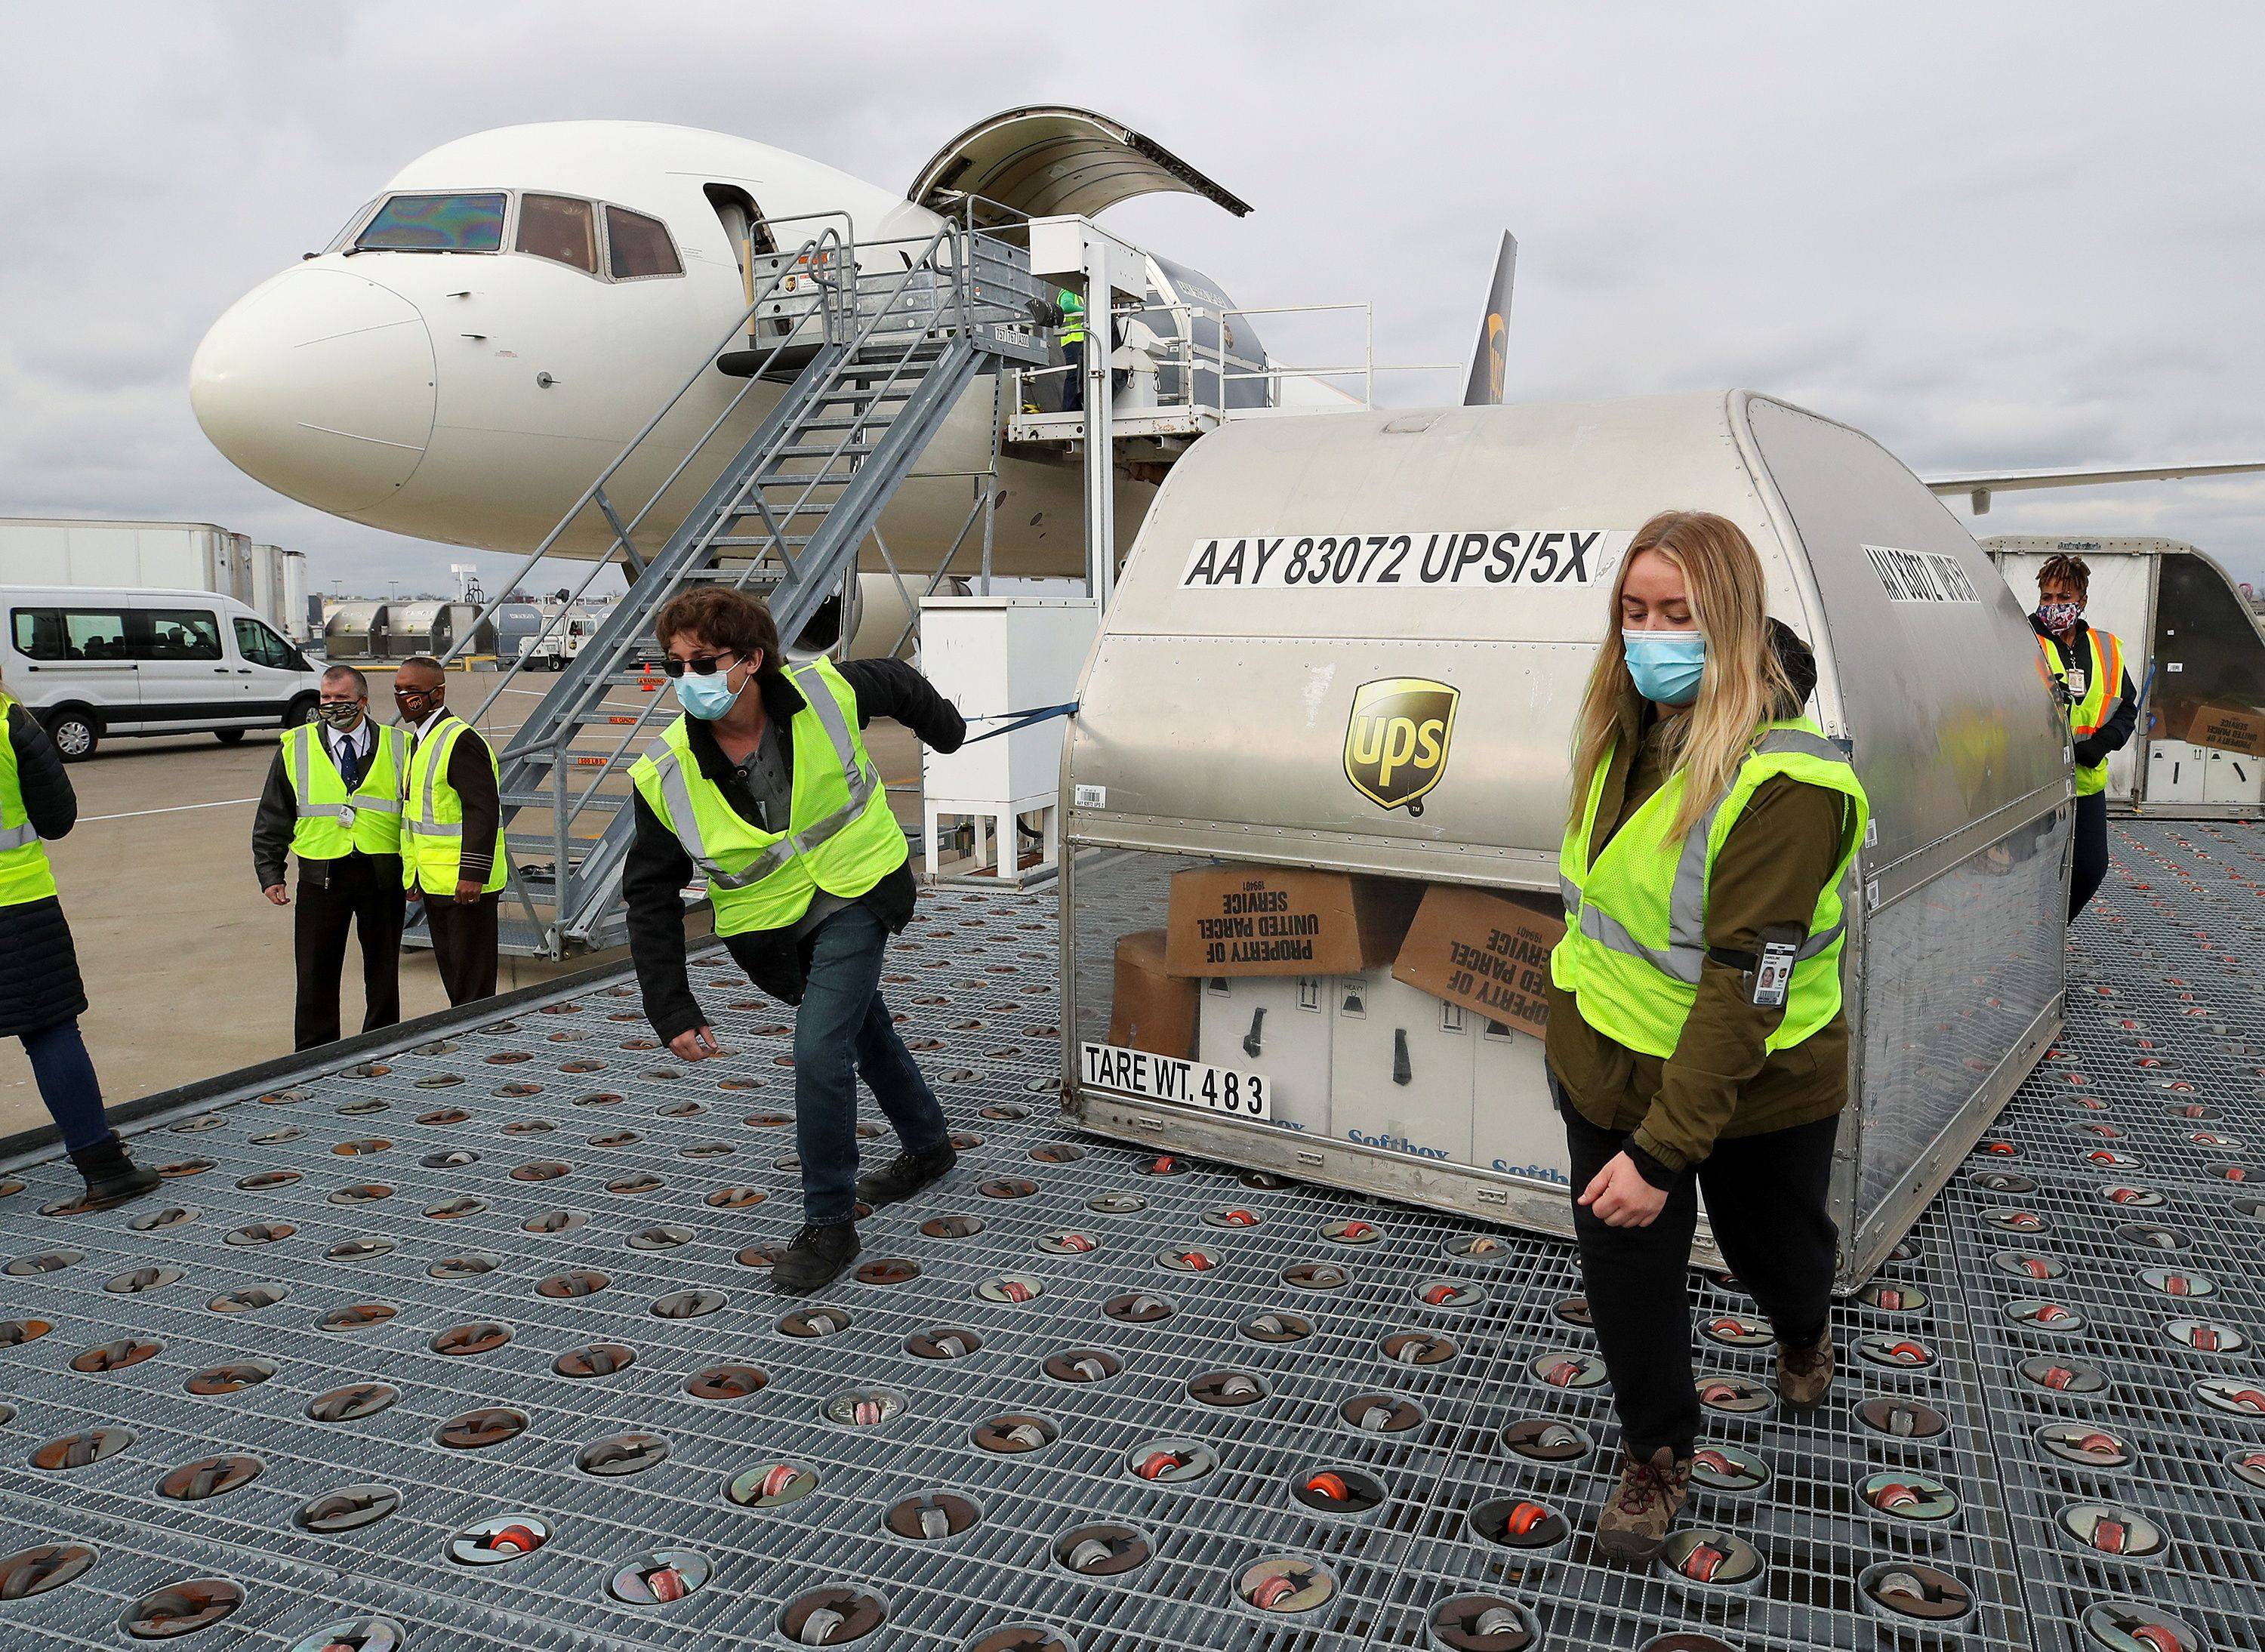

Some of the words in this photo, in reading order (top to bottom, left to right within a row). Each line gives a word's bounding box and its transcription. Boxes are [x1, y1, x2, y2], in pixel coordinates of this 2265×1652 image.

[996, 328, 1005, 341] 757
[1008, 331, 1016, 344] 767
[1018, 334, 1028, 346] A300
[1185, 538, 1284, 585] AAY
[1284, 535, 1412, 584] 83072
[1419, 532, 1601, 584] UPS/5X
[1865, 548, 1909, 600] AAY
[1888, 550, 1944, 603] 83072
[1926, 554, 1980, 602] UPS/5X
[408, 699, 422, 709] ups
[2207, 725, 2231, 736] PARCEL
[2220, 719, 2248, 731] SERVICE
[2232, 730, 2257, 741] UNITED
[1353, 715, 1444, 787] ups
[2217, 736, 2251, 749] PROPERTY
[1243, 880, 1265, 891] 199401
[1222, 891, 1288, 914] SERVICE
[1197, 917, 1254, 940] PARCEL
[1258, 914, 1319, 937] UNITED
[1517, 925, 1543, 943] 199401
[1207, 942, 1226, 963] OF
[1231, 938, 1313, 963] PROPERTY
[1486, 928, 1550, 969] ERVICE
[1450, 940, 1518, 985] PARCEL
[1446, 970, 1474, 995] OF
[1475, 981, 1550, 1025] OPERTY
[1085, 1046, 1147, 1093] TARE
[1154, 1057, 1194, 1102] WT.
